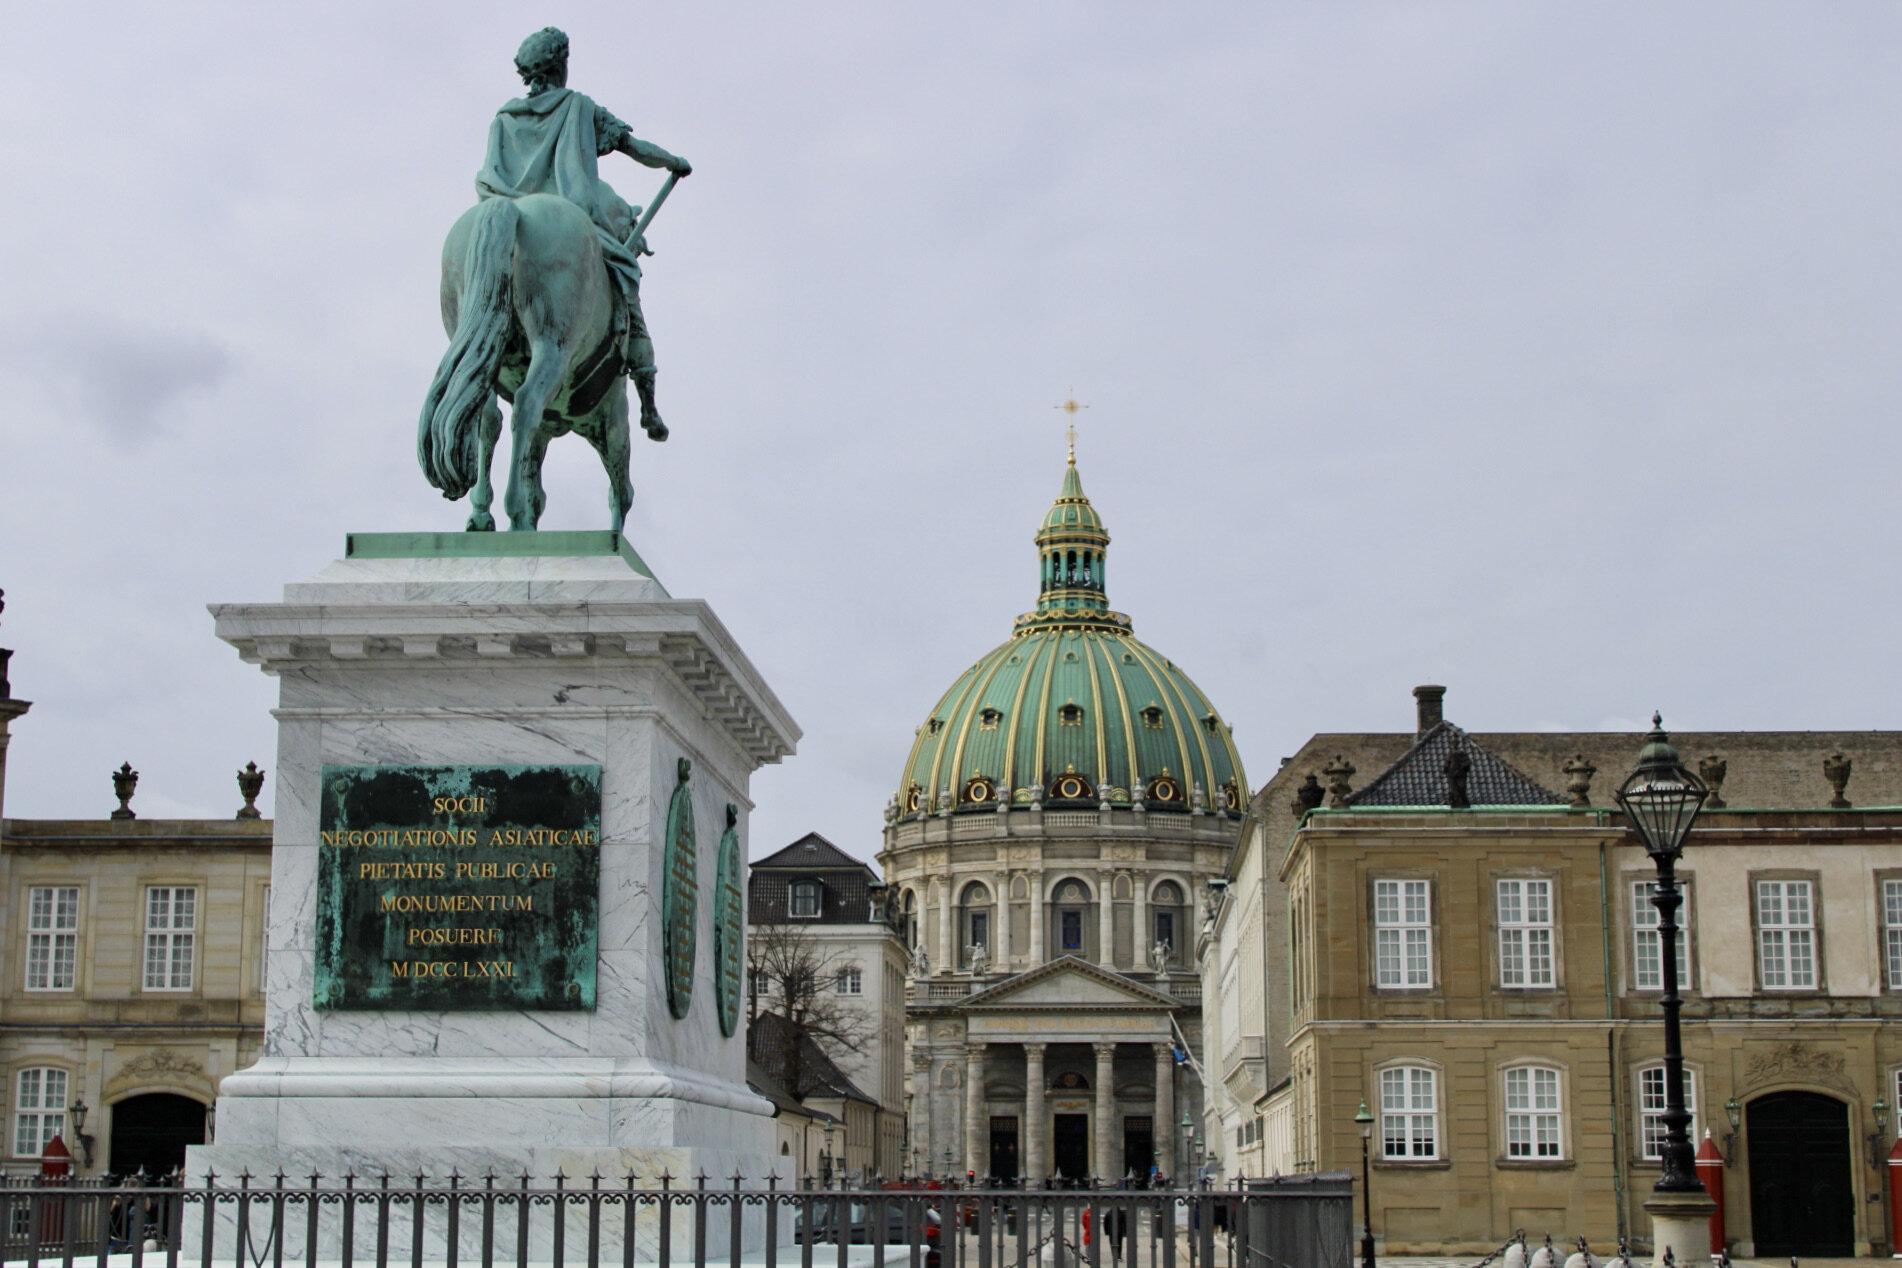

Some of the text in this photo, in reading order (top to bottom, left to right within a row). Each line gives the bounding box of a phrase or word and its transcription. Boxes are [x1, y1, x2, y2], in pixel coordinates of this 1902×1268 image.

[432, 797, 485, 813] SOCII
[320, 829, 599, 848] NEGOTIATIONIS ASIATICAE
[359, 862, 556, 879] PIETATIS PUBLICAE
[380, 895, 533, 912] MONUMENTUM
[408, 928, 502, 945] POSUERE
